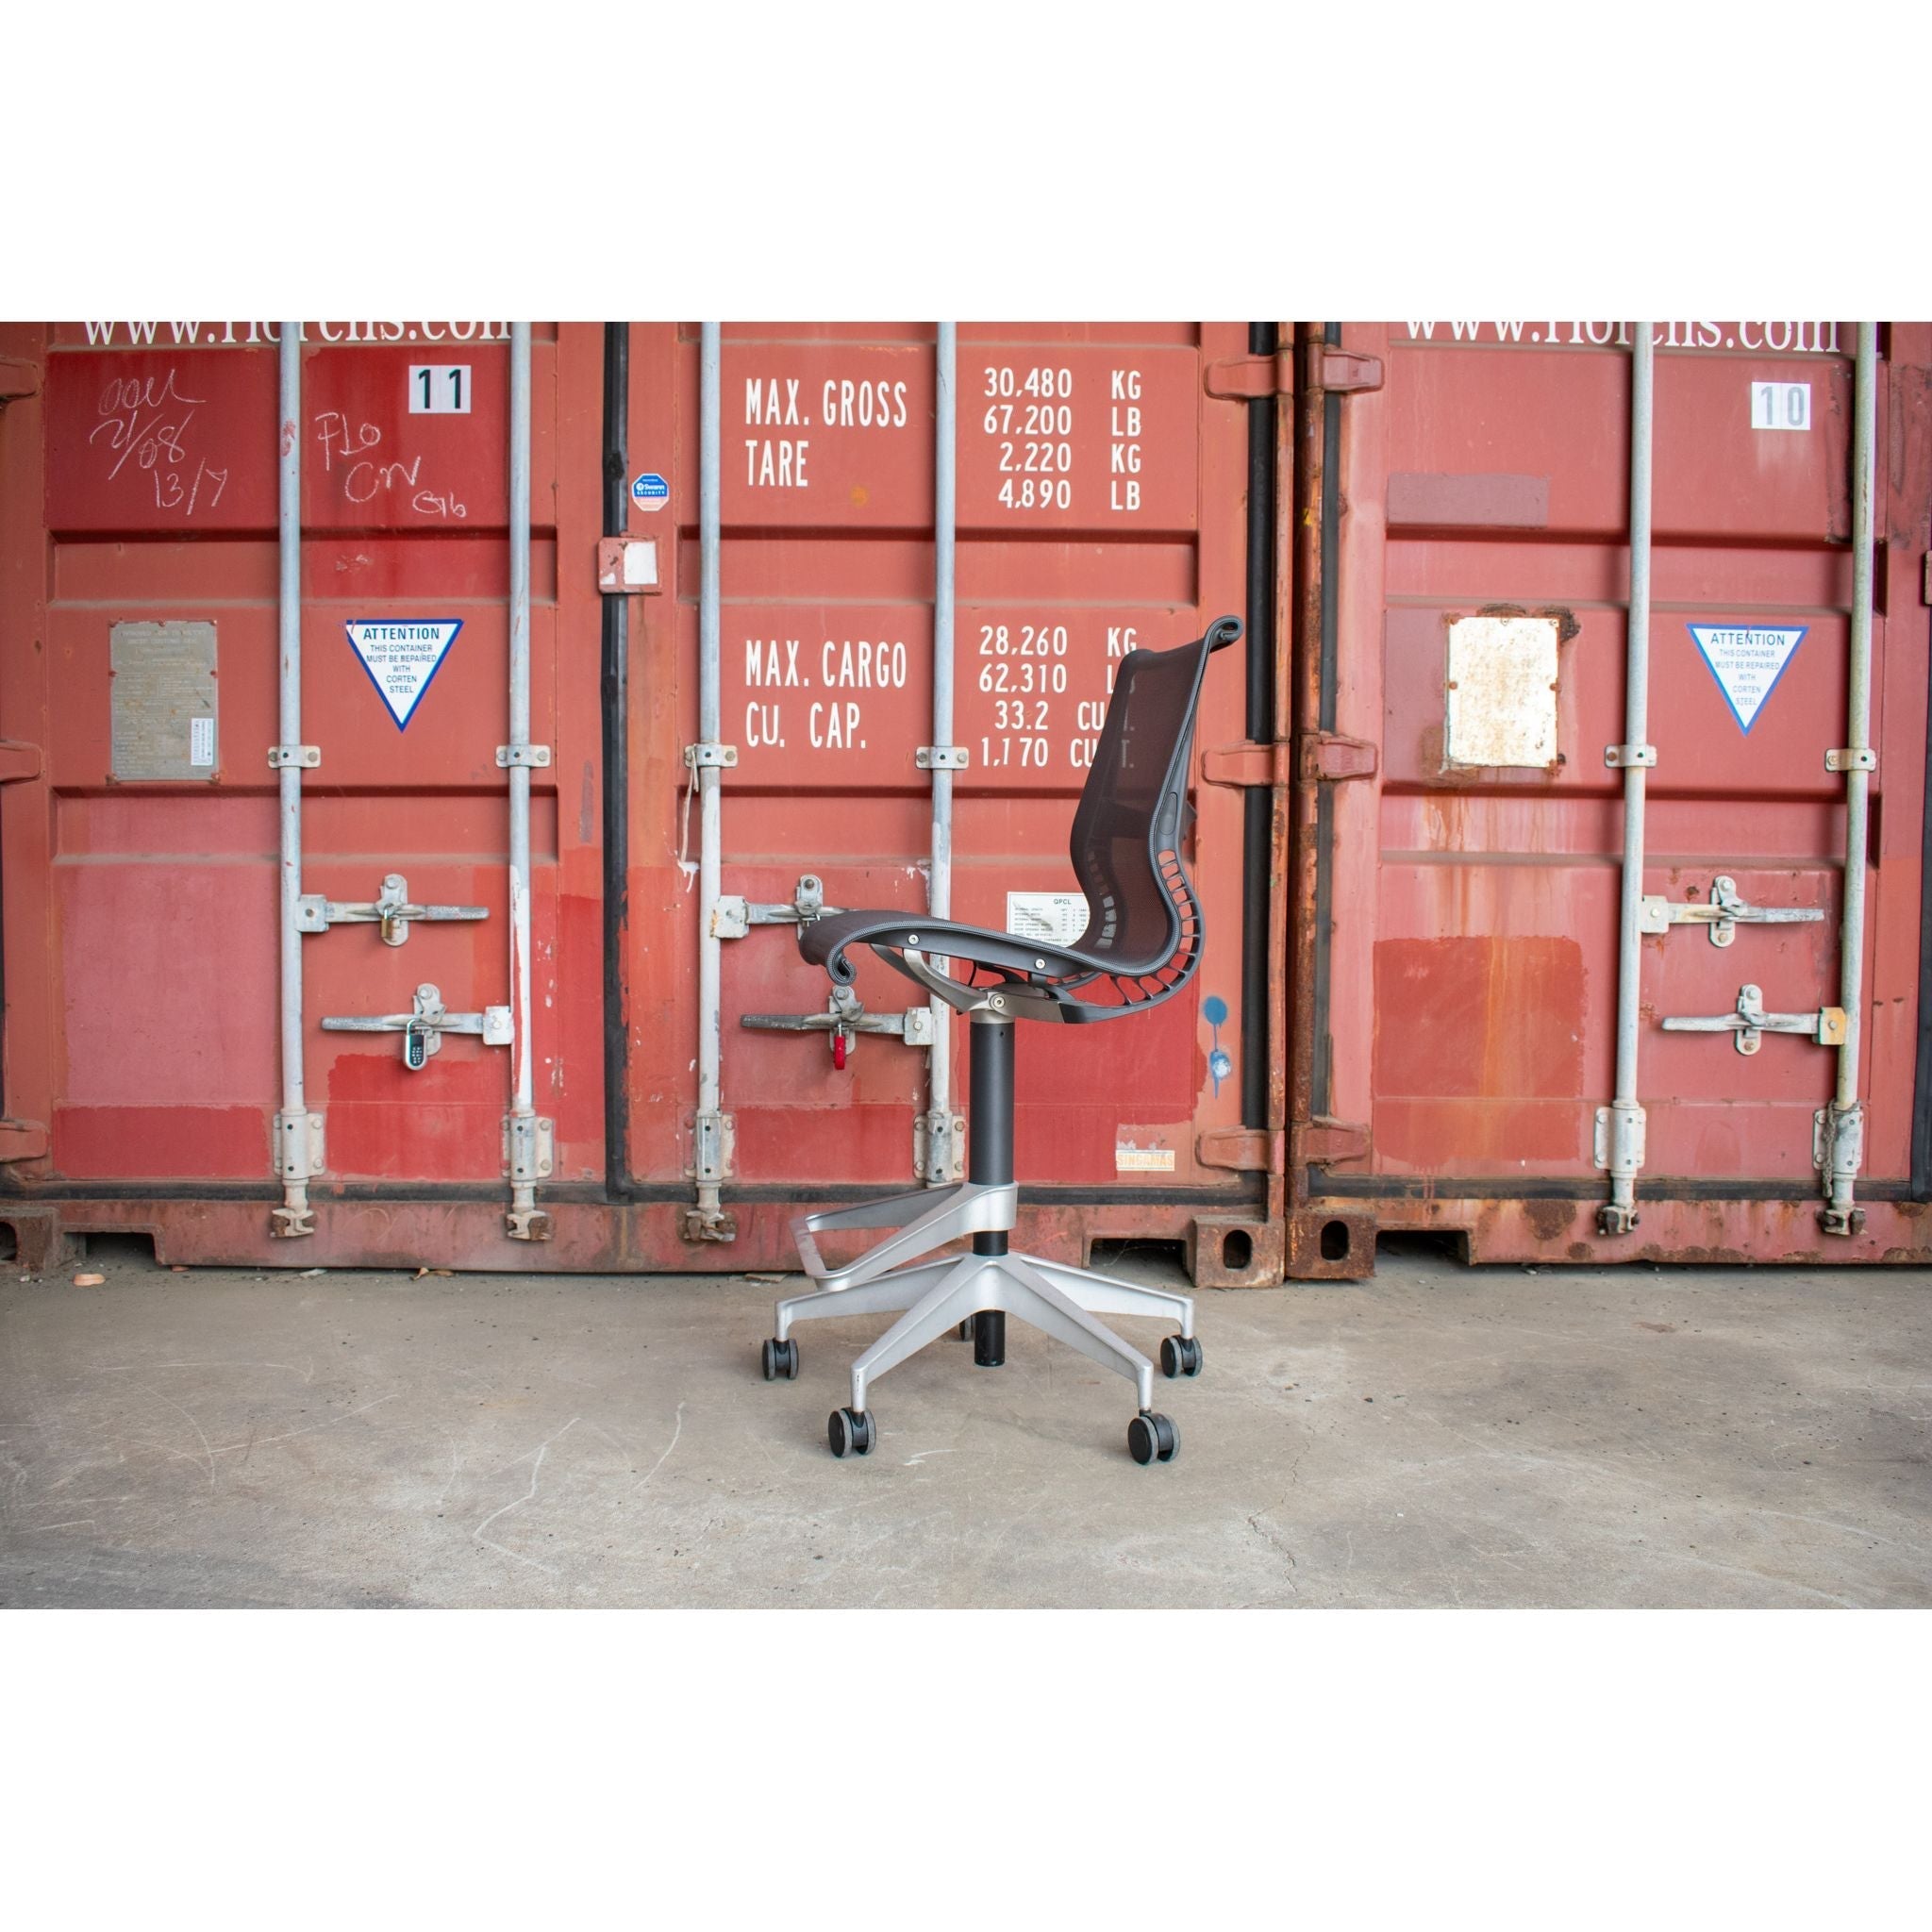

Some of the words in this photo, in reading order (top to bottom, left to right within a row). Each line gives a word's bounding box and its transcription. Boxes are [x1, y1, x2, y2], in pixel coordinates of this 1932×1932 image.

[418, 369, 461, 409] 11
[984, 367, 1073, 398] 30,480
[1110, 370, 1141, 400] KG
[743, 377, 809, 425] MAX.
[823, 379, 907, 427] GROSS
[1759, 386, 1806, 425] 10
[983, 405, 1073, 436] 67,200
[1111, 406, 1141, 437] LB
[745, 440, 809, 487] TARE
[999, 441, 1072, 473] 2,220
[1110, 443, 1141, 474] KG
[998, 478, 1072, 509] 4,890
[1110, 480, 1141, 510] LB
[363, 627, 441, 641] ATTENTION
[389, 644, 433, 653] CONTAINER
[979, 625, 1068, 657] 28,260
[1107, 627, 1137, 658] KG
[1710, 632, 1785, 646] ATTENTION
[366, 655, 386, 663] MUST
[745, 640, 809, 687] MAX.
[822, 641, 907, 689] CARGO
[386, 675, 417, 683] CORTEN
[389, 685, 414, 693] STEEL
[979, 663, 1067, 693] 62,310
[745, 701, 785, 748] CU.
[809, 702, 866, 749] CAP.
[994, 700, 1049, 730] 33.2
[981, 737, 1049, 767] 1,170
